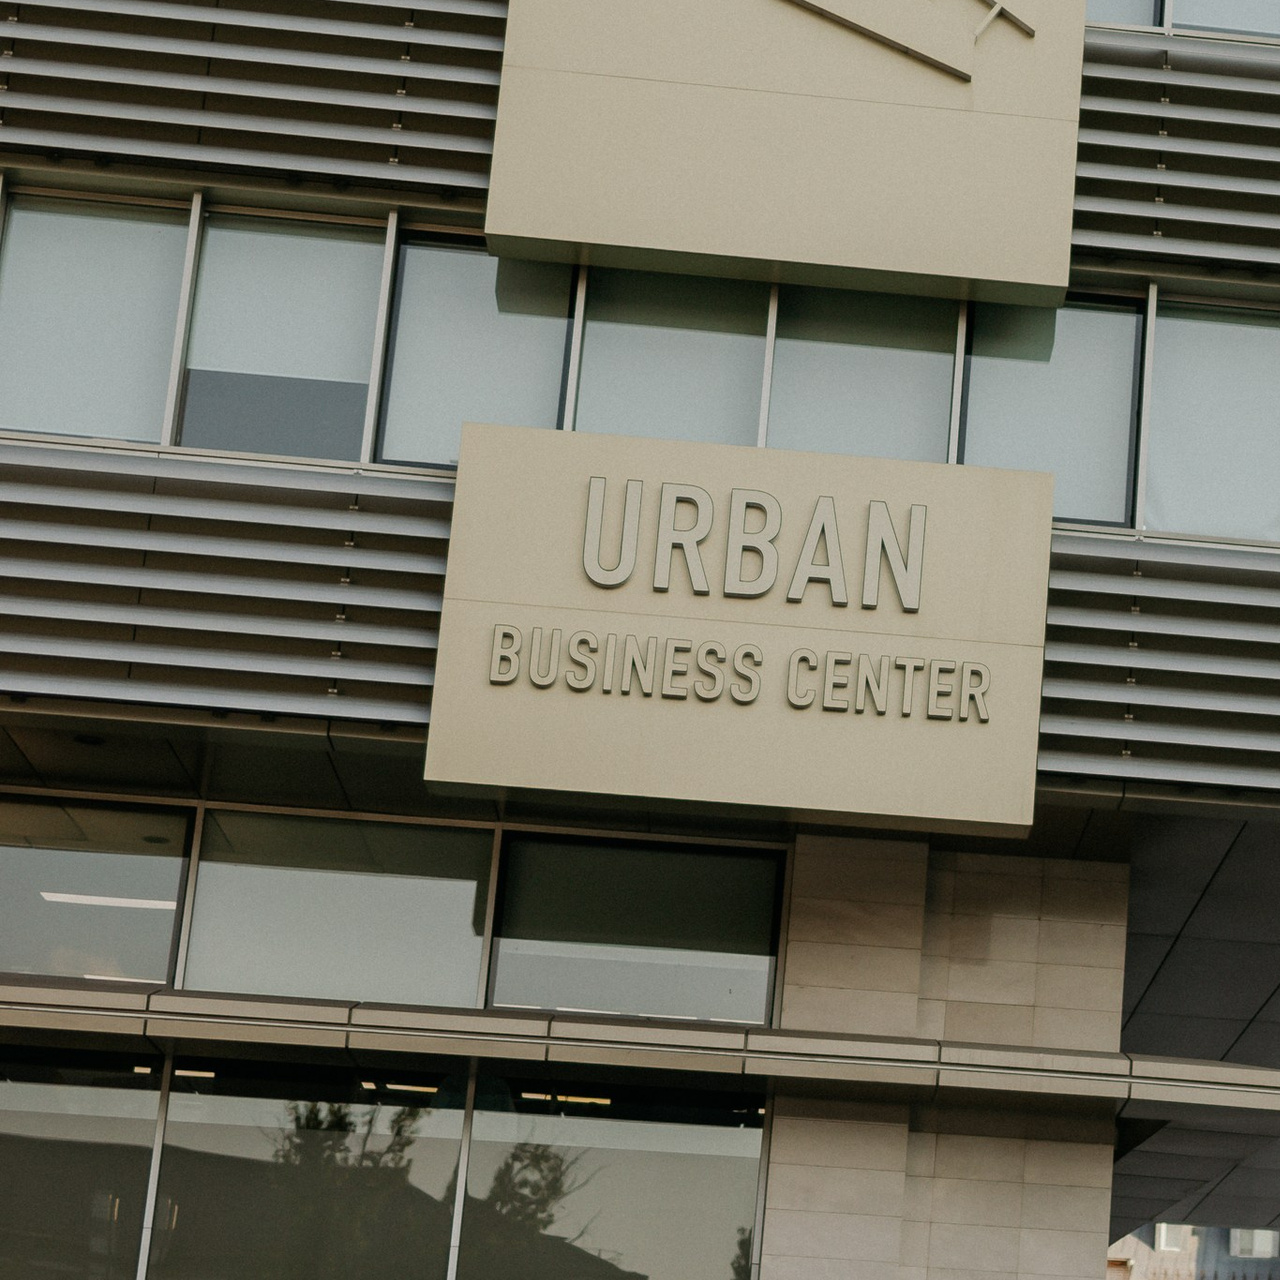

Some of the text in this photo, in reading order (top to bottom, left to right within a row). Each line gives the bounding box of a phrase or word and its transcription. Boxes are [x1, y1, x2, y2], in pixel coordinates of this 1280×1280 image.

[582, 476, 927, 613] URBAN
[489, 624, 991, 722] BUSINESS CENTER
